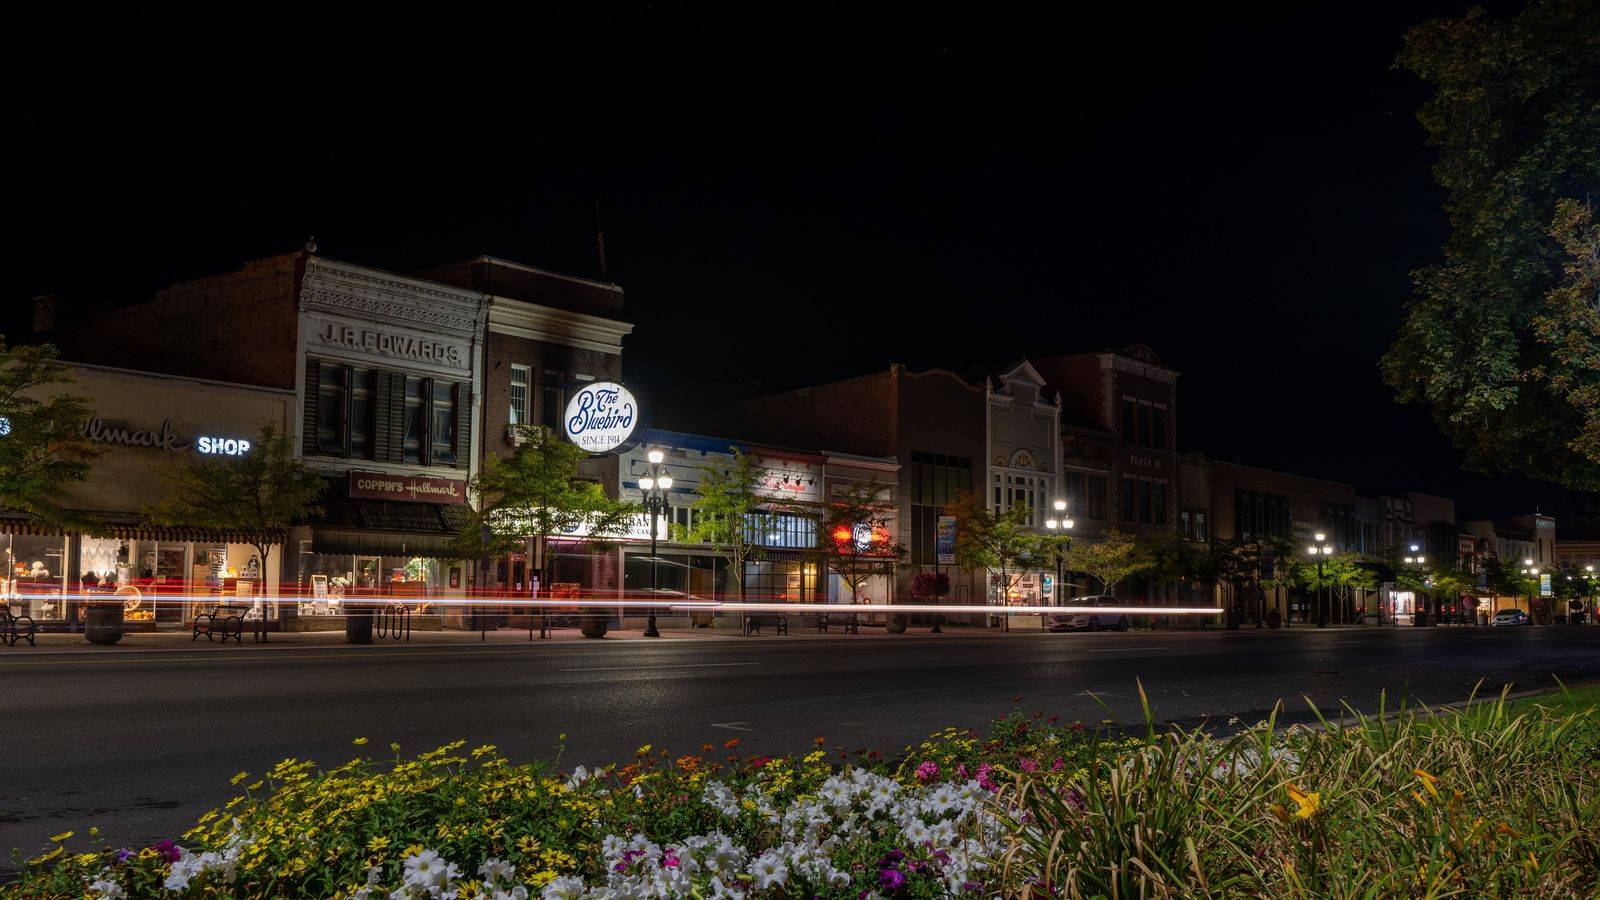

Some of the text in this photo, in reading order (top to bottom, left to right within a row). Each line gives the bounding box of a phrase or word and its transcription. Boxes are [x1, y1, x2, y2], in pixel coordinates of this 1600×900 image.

[569, 390, 633, 434] Bluebird
[596, 387, 620, 412] The
[81, 415, 250, 456] llmark SHOP
[581, 435, 605, 445] SINCE
[357, 479, 404, 493] COPPIN'S
